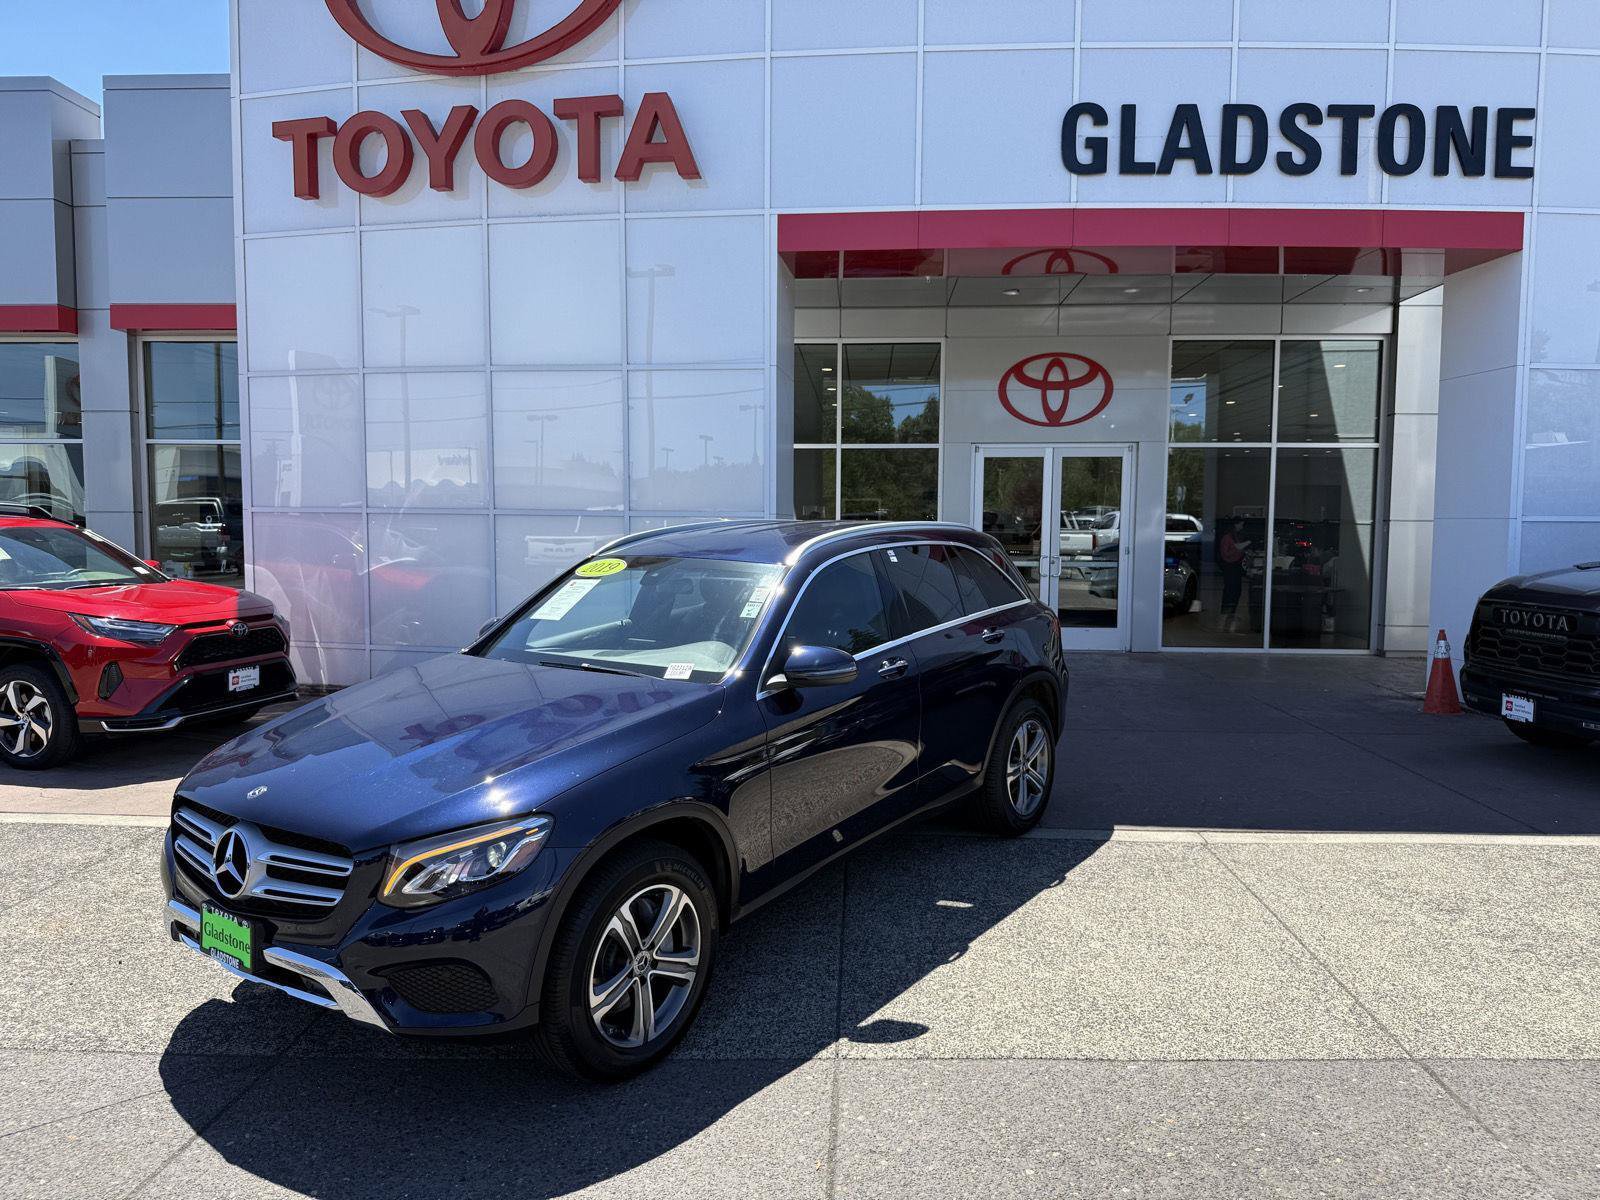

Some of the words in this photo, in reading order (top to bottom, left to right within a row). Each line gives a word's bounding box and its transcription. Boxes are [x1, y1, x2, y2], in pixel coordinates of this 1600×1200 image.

[272, 92, 702, 200] TOYOTA
[1061, 102, 1536, 179] GLADSTONE
[580, 561, 622, 574] 2019
[1500, 609, 1569, 632] TOYOTA
[210, 906, 239, 925] TOYOTA
[203, 921, 252, 955] Gladstone
[210, 947, 240, 969] GLADSTONE
